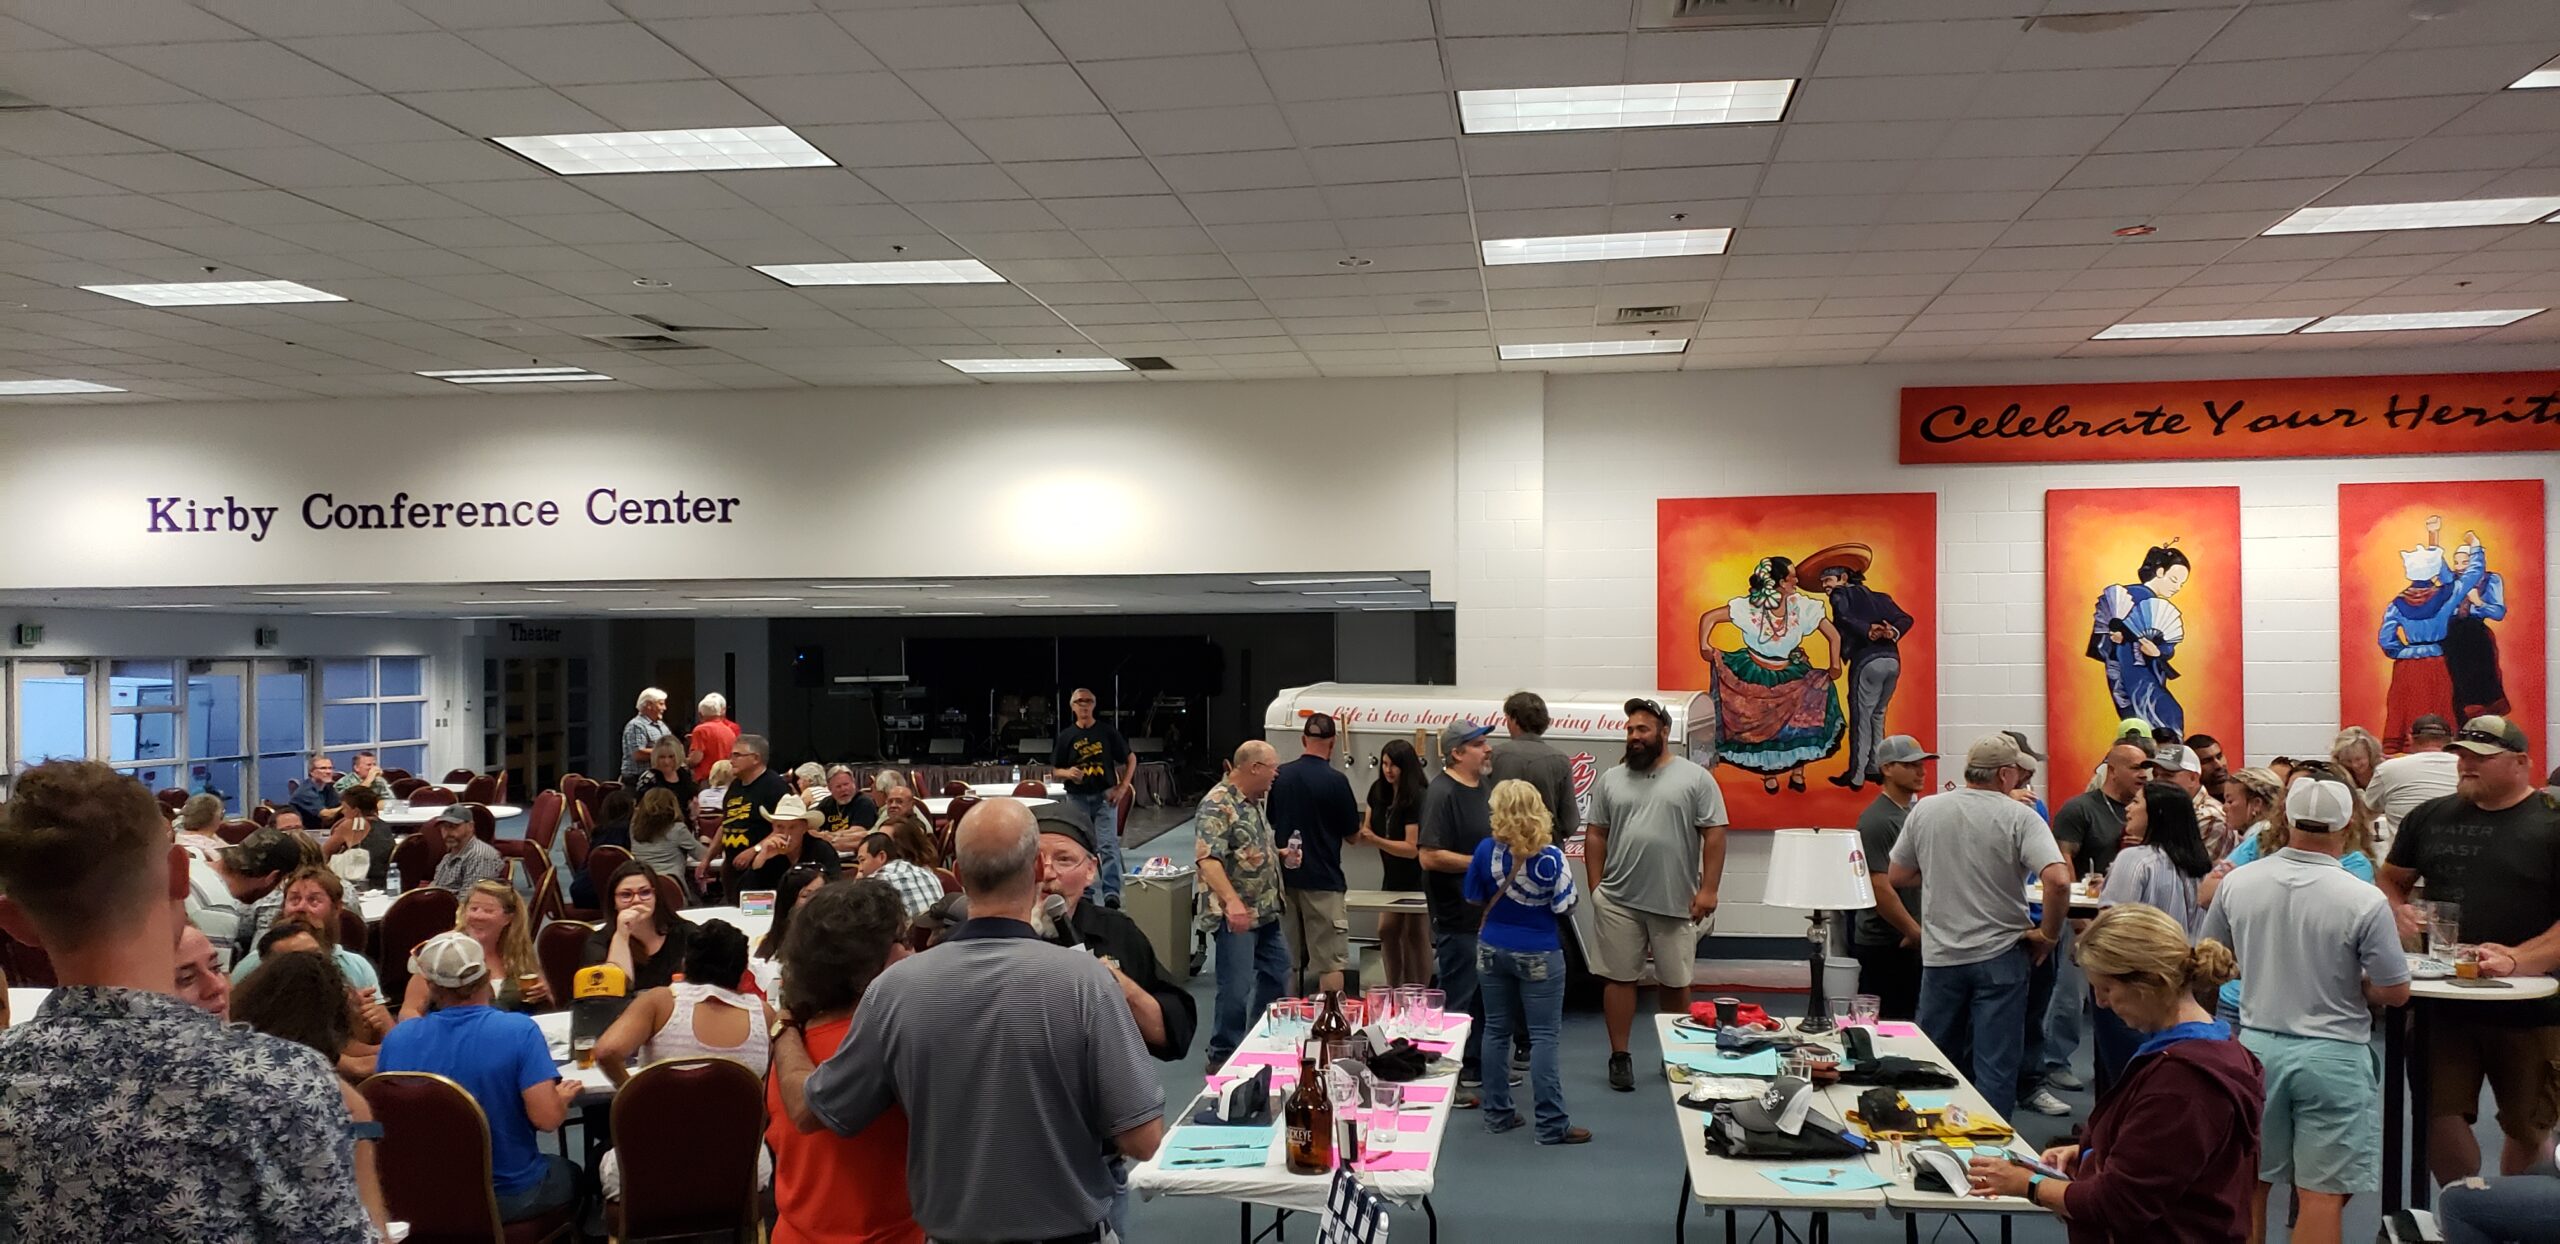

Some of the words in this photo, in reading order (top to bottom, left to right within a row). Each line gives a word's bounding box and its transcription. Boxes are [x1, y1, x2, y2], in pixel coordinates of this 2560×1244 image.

[1920, 402, 2191, 443] Celebrate
[2203, 400, 2368, 437] Your
[2384, 392, 2560, 430] Herit
[146, 495, 279, 542] Kirby
[302, 492, 560, 530] Conference
[586, 488, 741, 525] Center
[509, 622, 561, 641] Theater
[1332, 705, 1362, 725] Lfe
[1367, 708, 1379, 722] is
[1384, 709, 1409, 723] too
[1414, 709, 1459, 725] short
[1483, 711, 1507, 727] dri
[1550, 714, 1592, 733] ring
